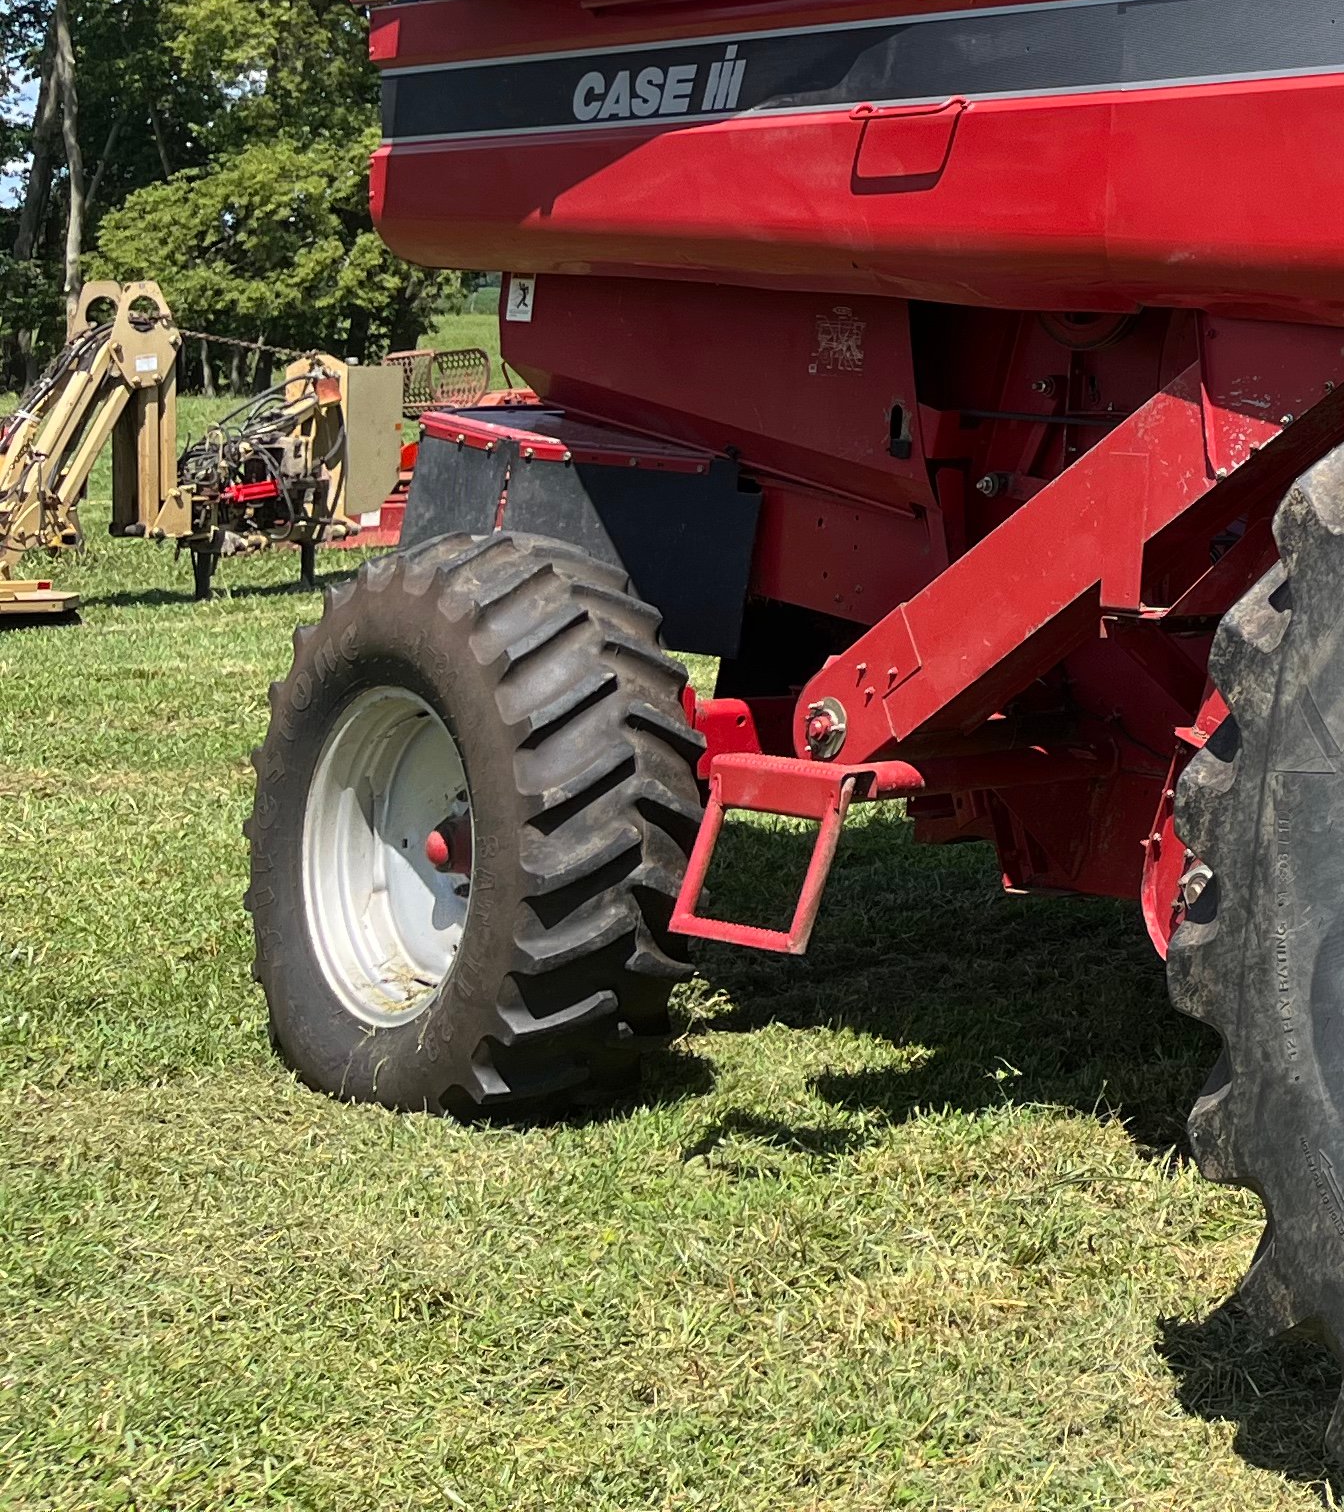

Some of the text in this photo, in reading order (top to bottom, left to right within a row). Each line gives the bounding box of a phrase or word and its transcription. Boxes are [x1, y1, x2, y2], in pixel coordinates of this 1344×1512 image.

[573, 64, 697, 122] CASE
[1277, 921, 1290, 993] RATING
[1281, 999, 1295, 1033] PLY
